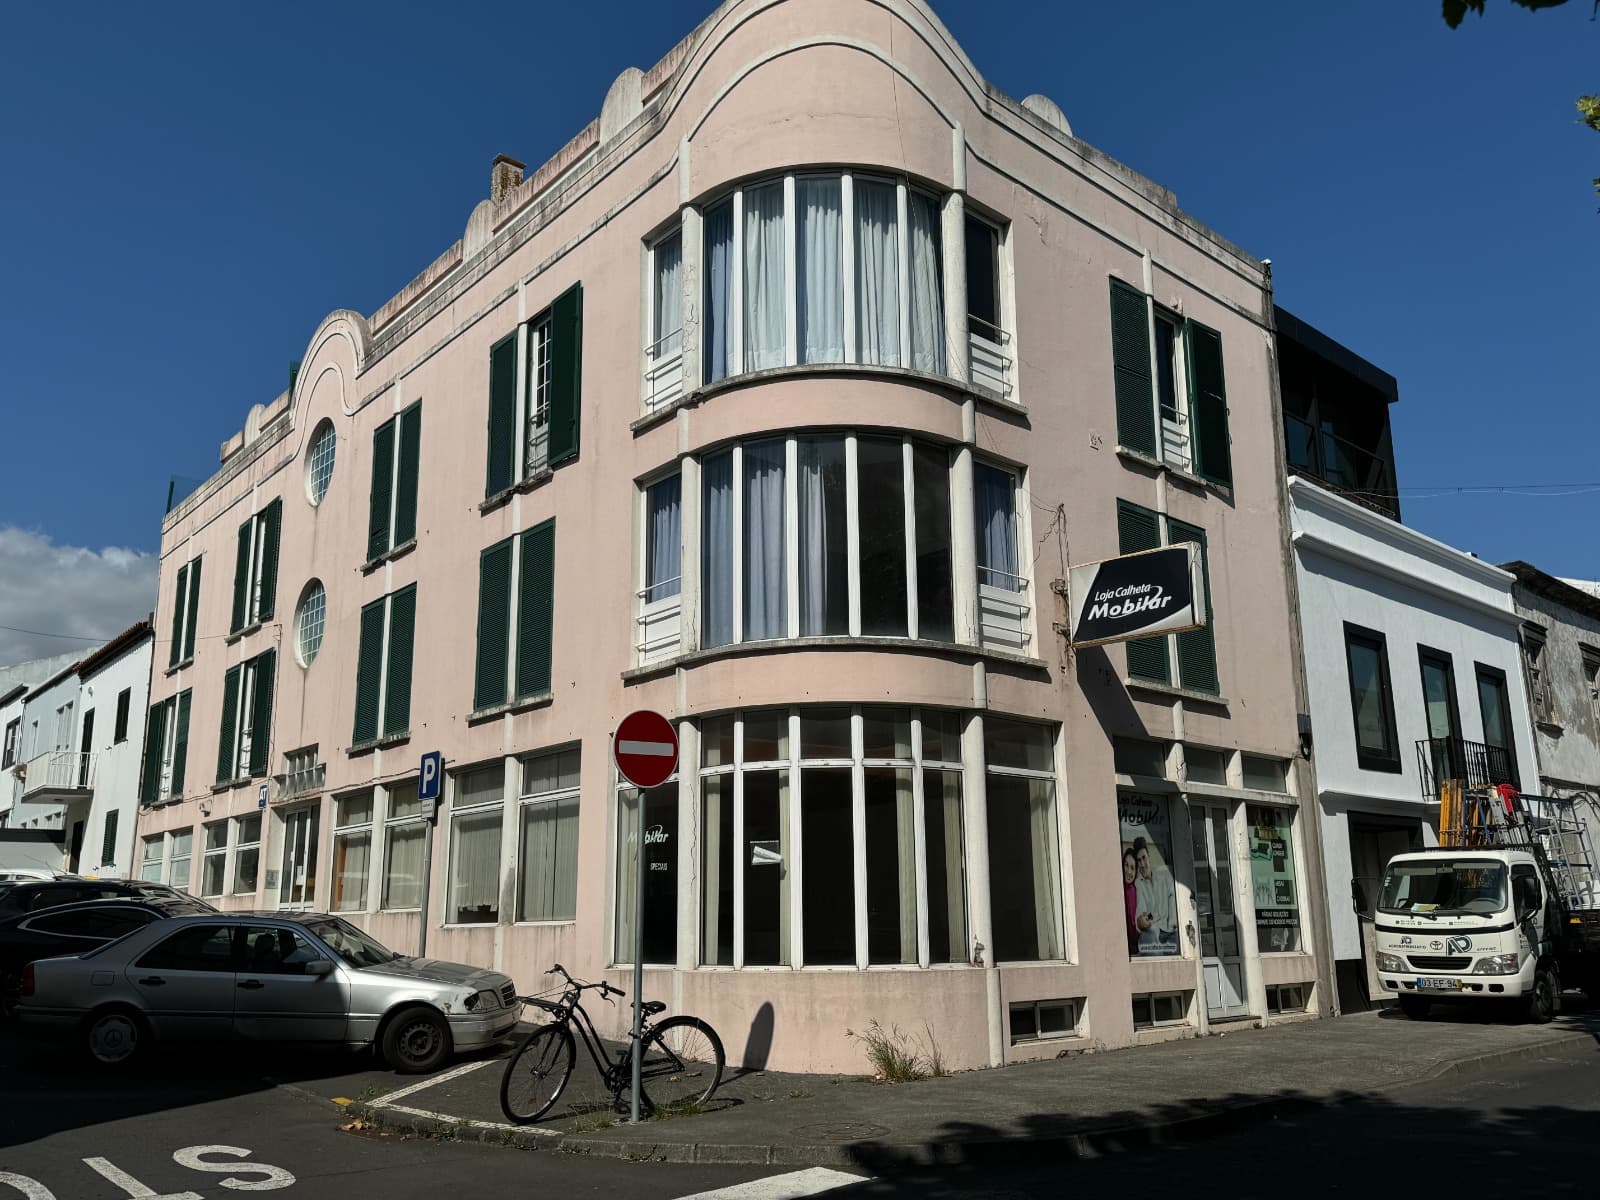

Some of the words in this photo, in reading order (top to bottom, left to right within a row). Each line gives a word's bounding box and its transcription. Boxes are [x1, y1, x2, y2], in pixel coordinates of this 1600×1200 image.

[1095, 590, 1114, 602] Loja
[1115, 583, 1151, 598] Calheta
[422, 757, 436, 794] P
[627, 828, 669, 844] Mbilar
